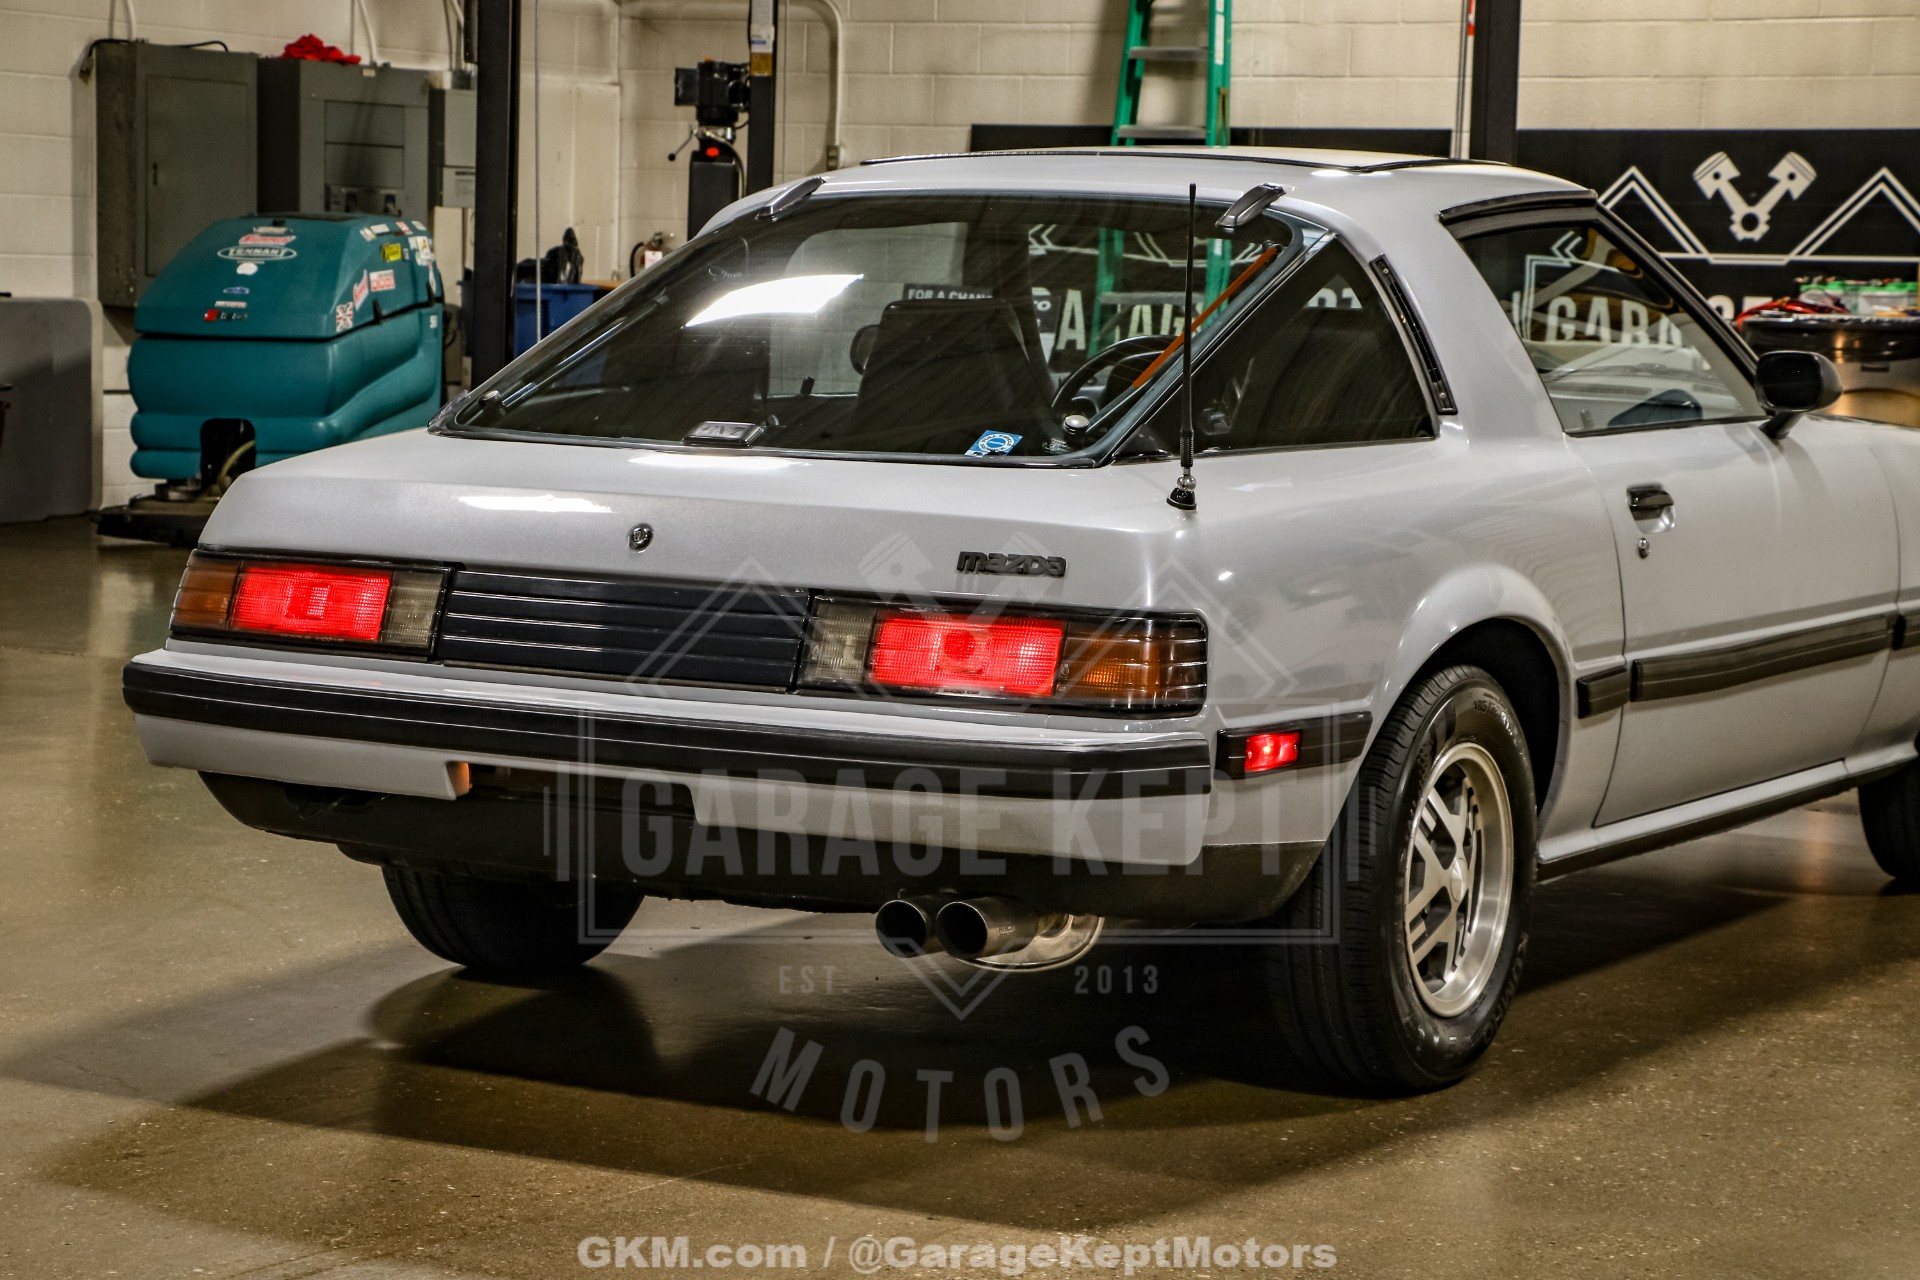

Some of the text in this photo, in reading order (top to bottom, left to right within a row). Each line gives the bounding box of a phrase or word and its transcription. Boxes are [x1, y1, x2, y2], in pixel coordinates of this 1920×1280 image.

[908, 289, 933, 300] FOR
[937, 290, 945, 299] A
[957, 551, 1067, 578] mazda
